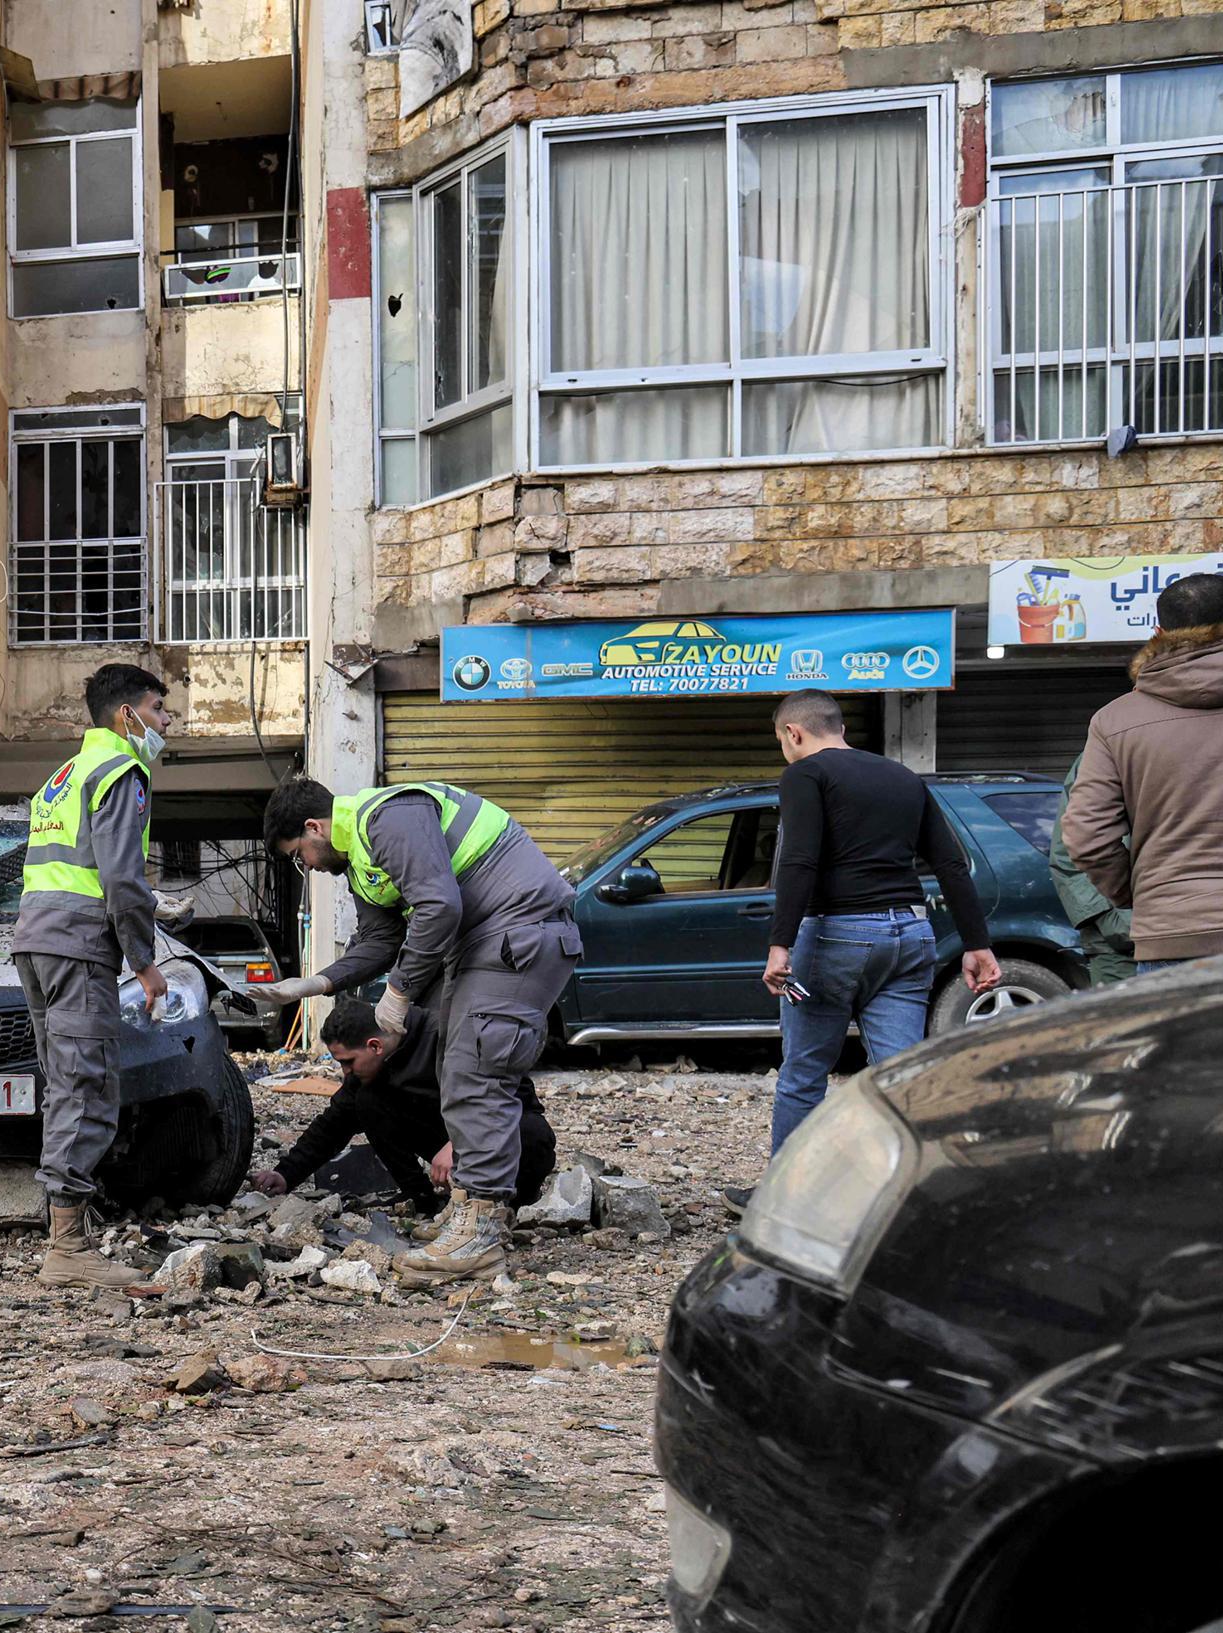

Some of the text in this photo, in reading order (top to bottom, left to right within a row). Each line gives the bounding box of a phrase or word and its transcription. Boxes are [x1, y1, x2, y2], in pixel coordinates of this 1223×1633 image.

[665, 643, 783, 664] ZAYOUN
[541, 663, 594, 677] GMC
[601, 662, 779, 679] AUTOMOTIVE SERVICE
[848, 669, 885, 680] Audi
[497, 680, 536, 690] TOYOTA
[630, 677, 749, 692] TEL: 70077821
